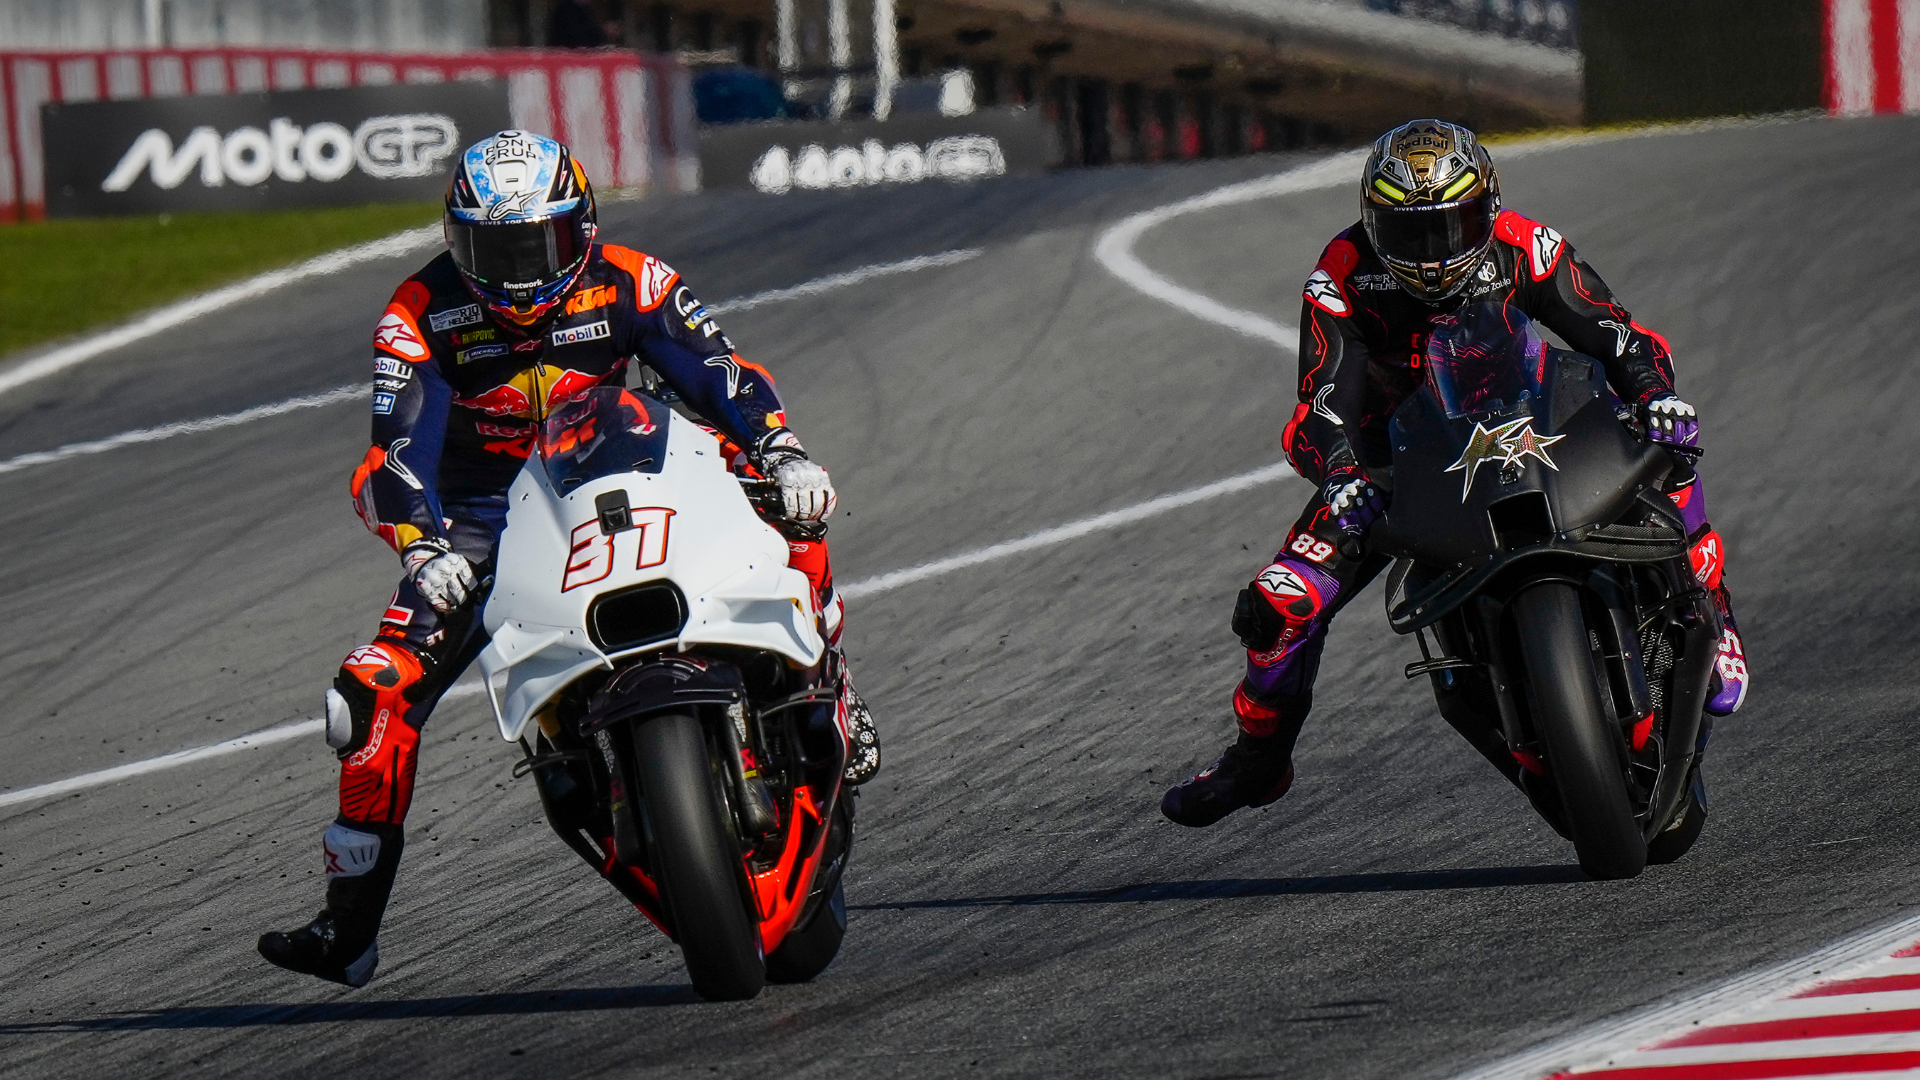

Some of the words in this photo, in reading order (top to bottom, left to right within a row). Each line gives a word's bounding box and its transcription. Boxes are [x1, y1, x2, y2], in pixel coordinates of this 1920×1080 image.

[102, 113, 460, 193] MotoGP
[1397, 138, 1421, 154] Red
[1423, 137, 1449, 150] Bull
[750, 134, 1006, 195] MotoGP
[503, 279, 543, 290] finetwork
[565, 284, 617, 316] KTM
[448, 313, 480, 327] HELMET
[554, 326, 593, 344] Mobil
[374, 360, 396, 373] obil
[475, 420, 539, 438] Red
[547, 396, 598, 434] Bull
[560, 506, 678, 593] 37
[1290, 532, 1335, 564] 89
[425, 628, 446, 648] 37
